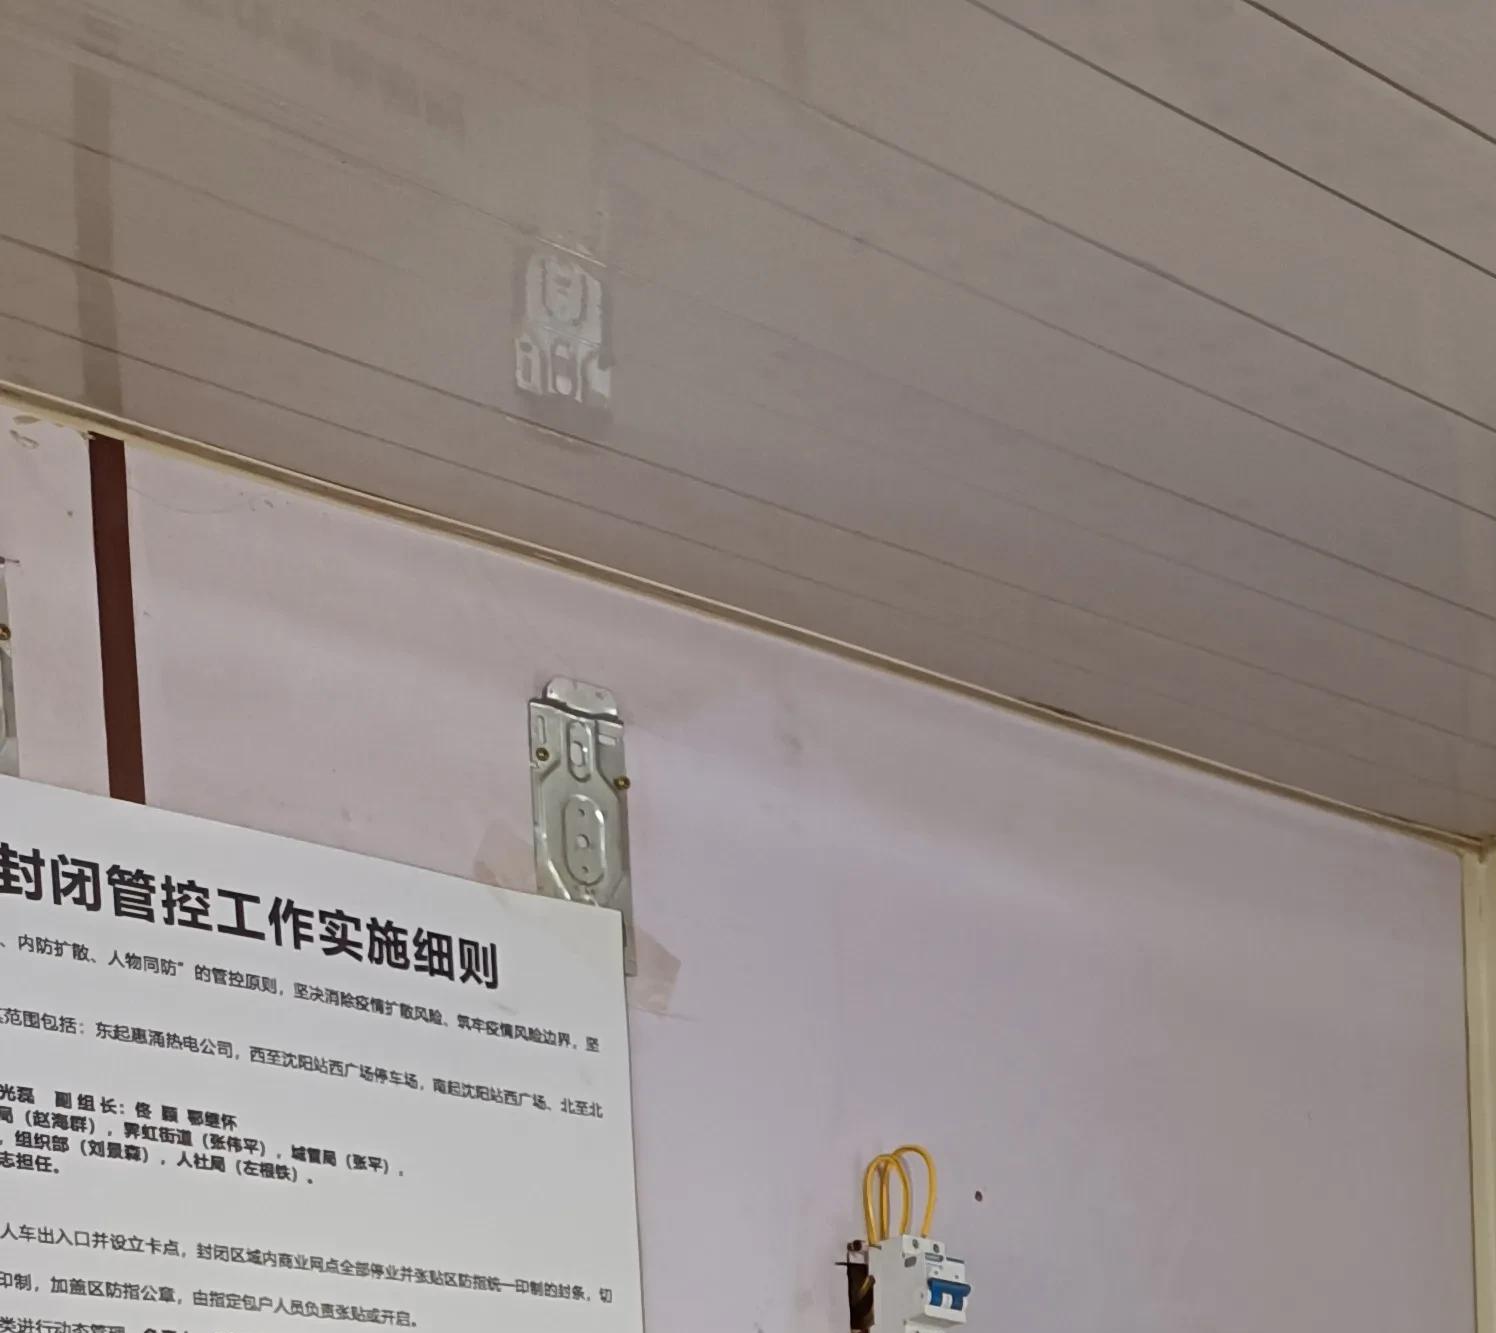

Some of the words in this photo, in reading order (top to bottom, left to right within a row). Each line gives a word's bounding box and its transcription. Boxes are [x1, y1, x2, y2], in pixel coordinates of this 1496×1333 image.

[0, 842, 498, 990] 封闭管控工作实施细则
